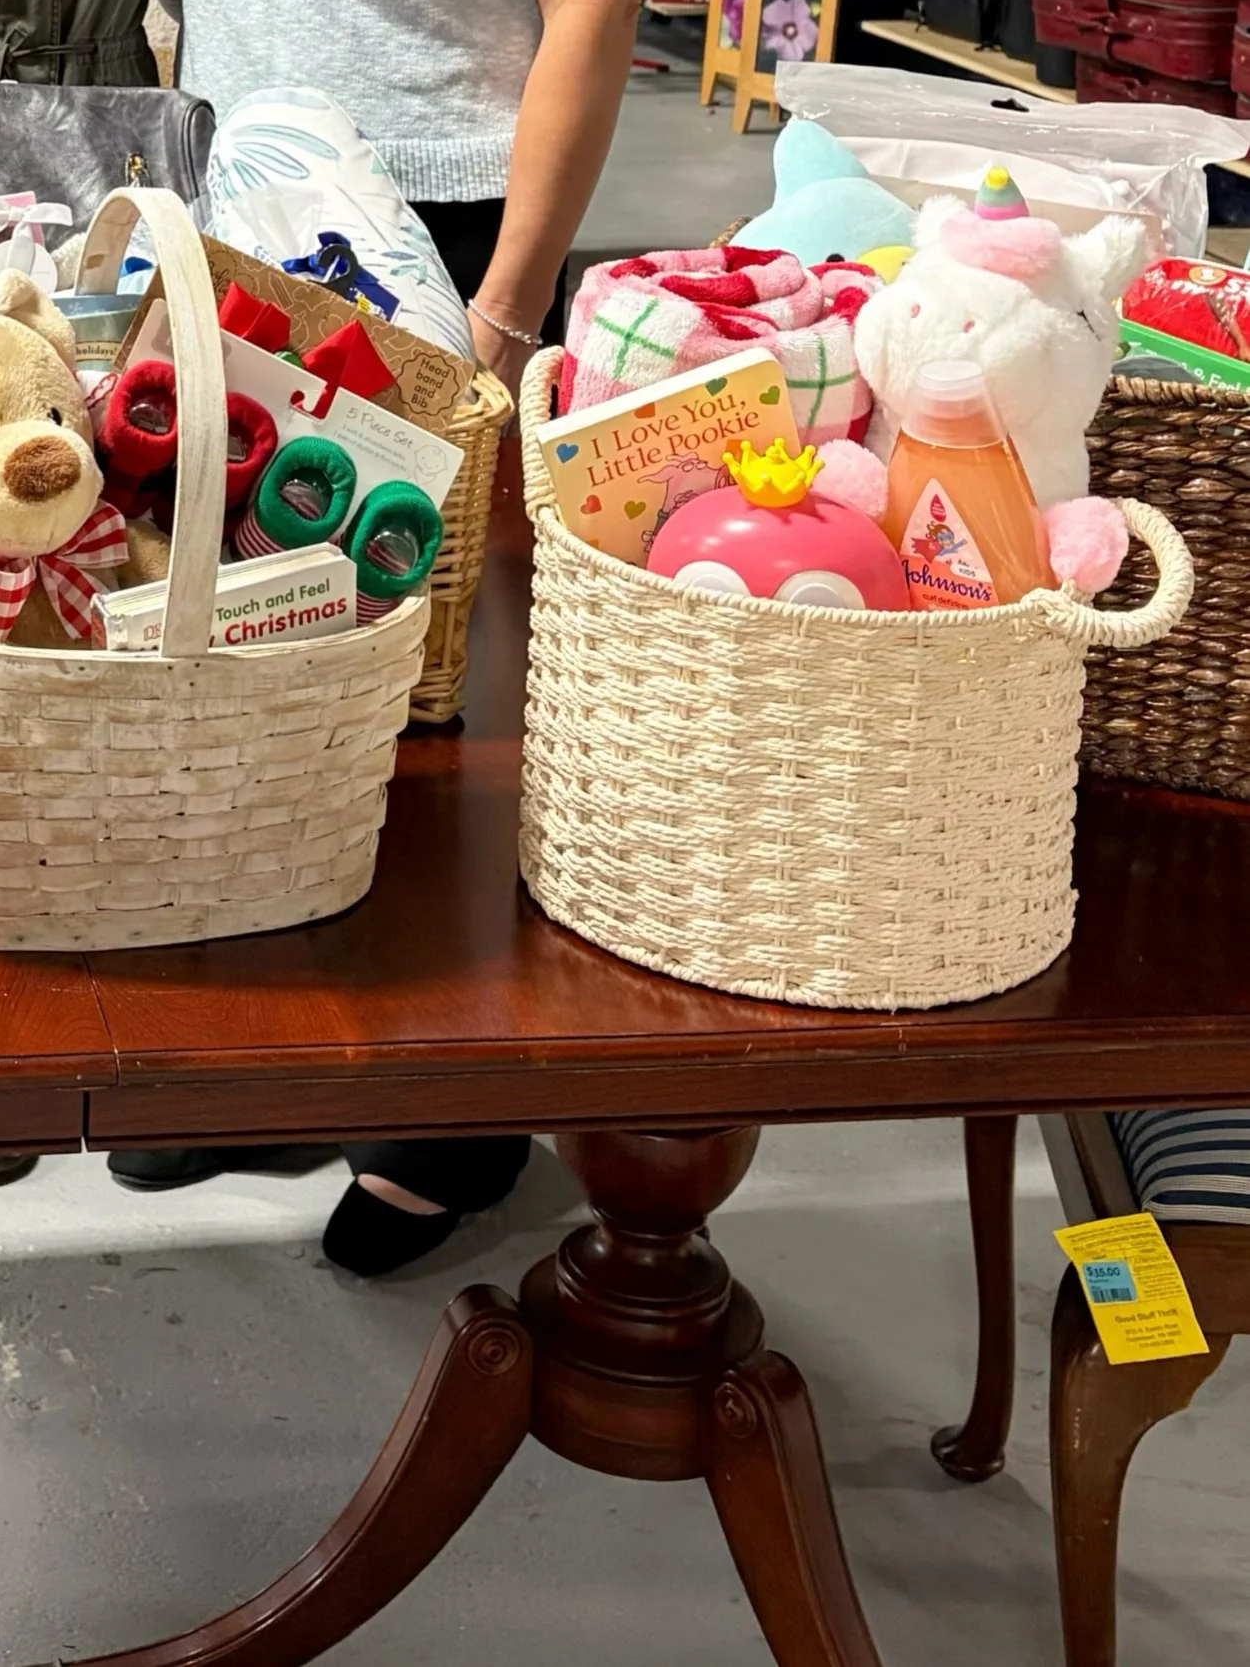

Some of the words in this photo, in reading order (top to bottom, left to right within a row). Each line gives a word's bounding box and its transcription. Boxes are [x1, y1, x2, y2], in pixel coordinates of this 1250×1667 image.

[415, 370, 445, 389] band
[419, 358, 450, 379] Head
[410, 393, 429, 409] Bib
[413, 381, 437, 399] and
[346, 407, 358, 420] 5
[361, 413, 391, 438] Piece
[393, 431, 414, 449] Set
[590, 437, 603, 460] I
[611, 412, 681, 452] Love
[681, 393, 746, 425] You,
[586, 442, 663, 488] Little
[667, 410, 760, 457] Pookie
[216, 596, 260, 622] Touch
[265, 588, 295, 609] and
[299, 578, 330, 600] Feel
[901, 558, 993, 602] Johnson's
[225, 597, 348, 647] Christmas
[1086, 1266, 1121, 1278] $35.00
